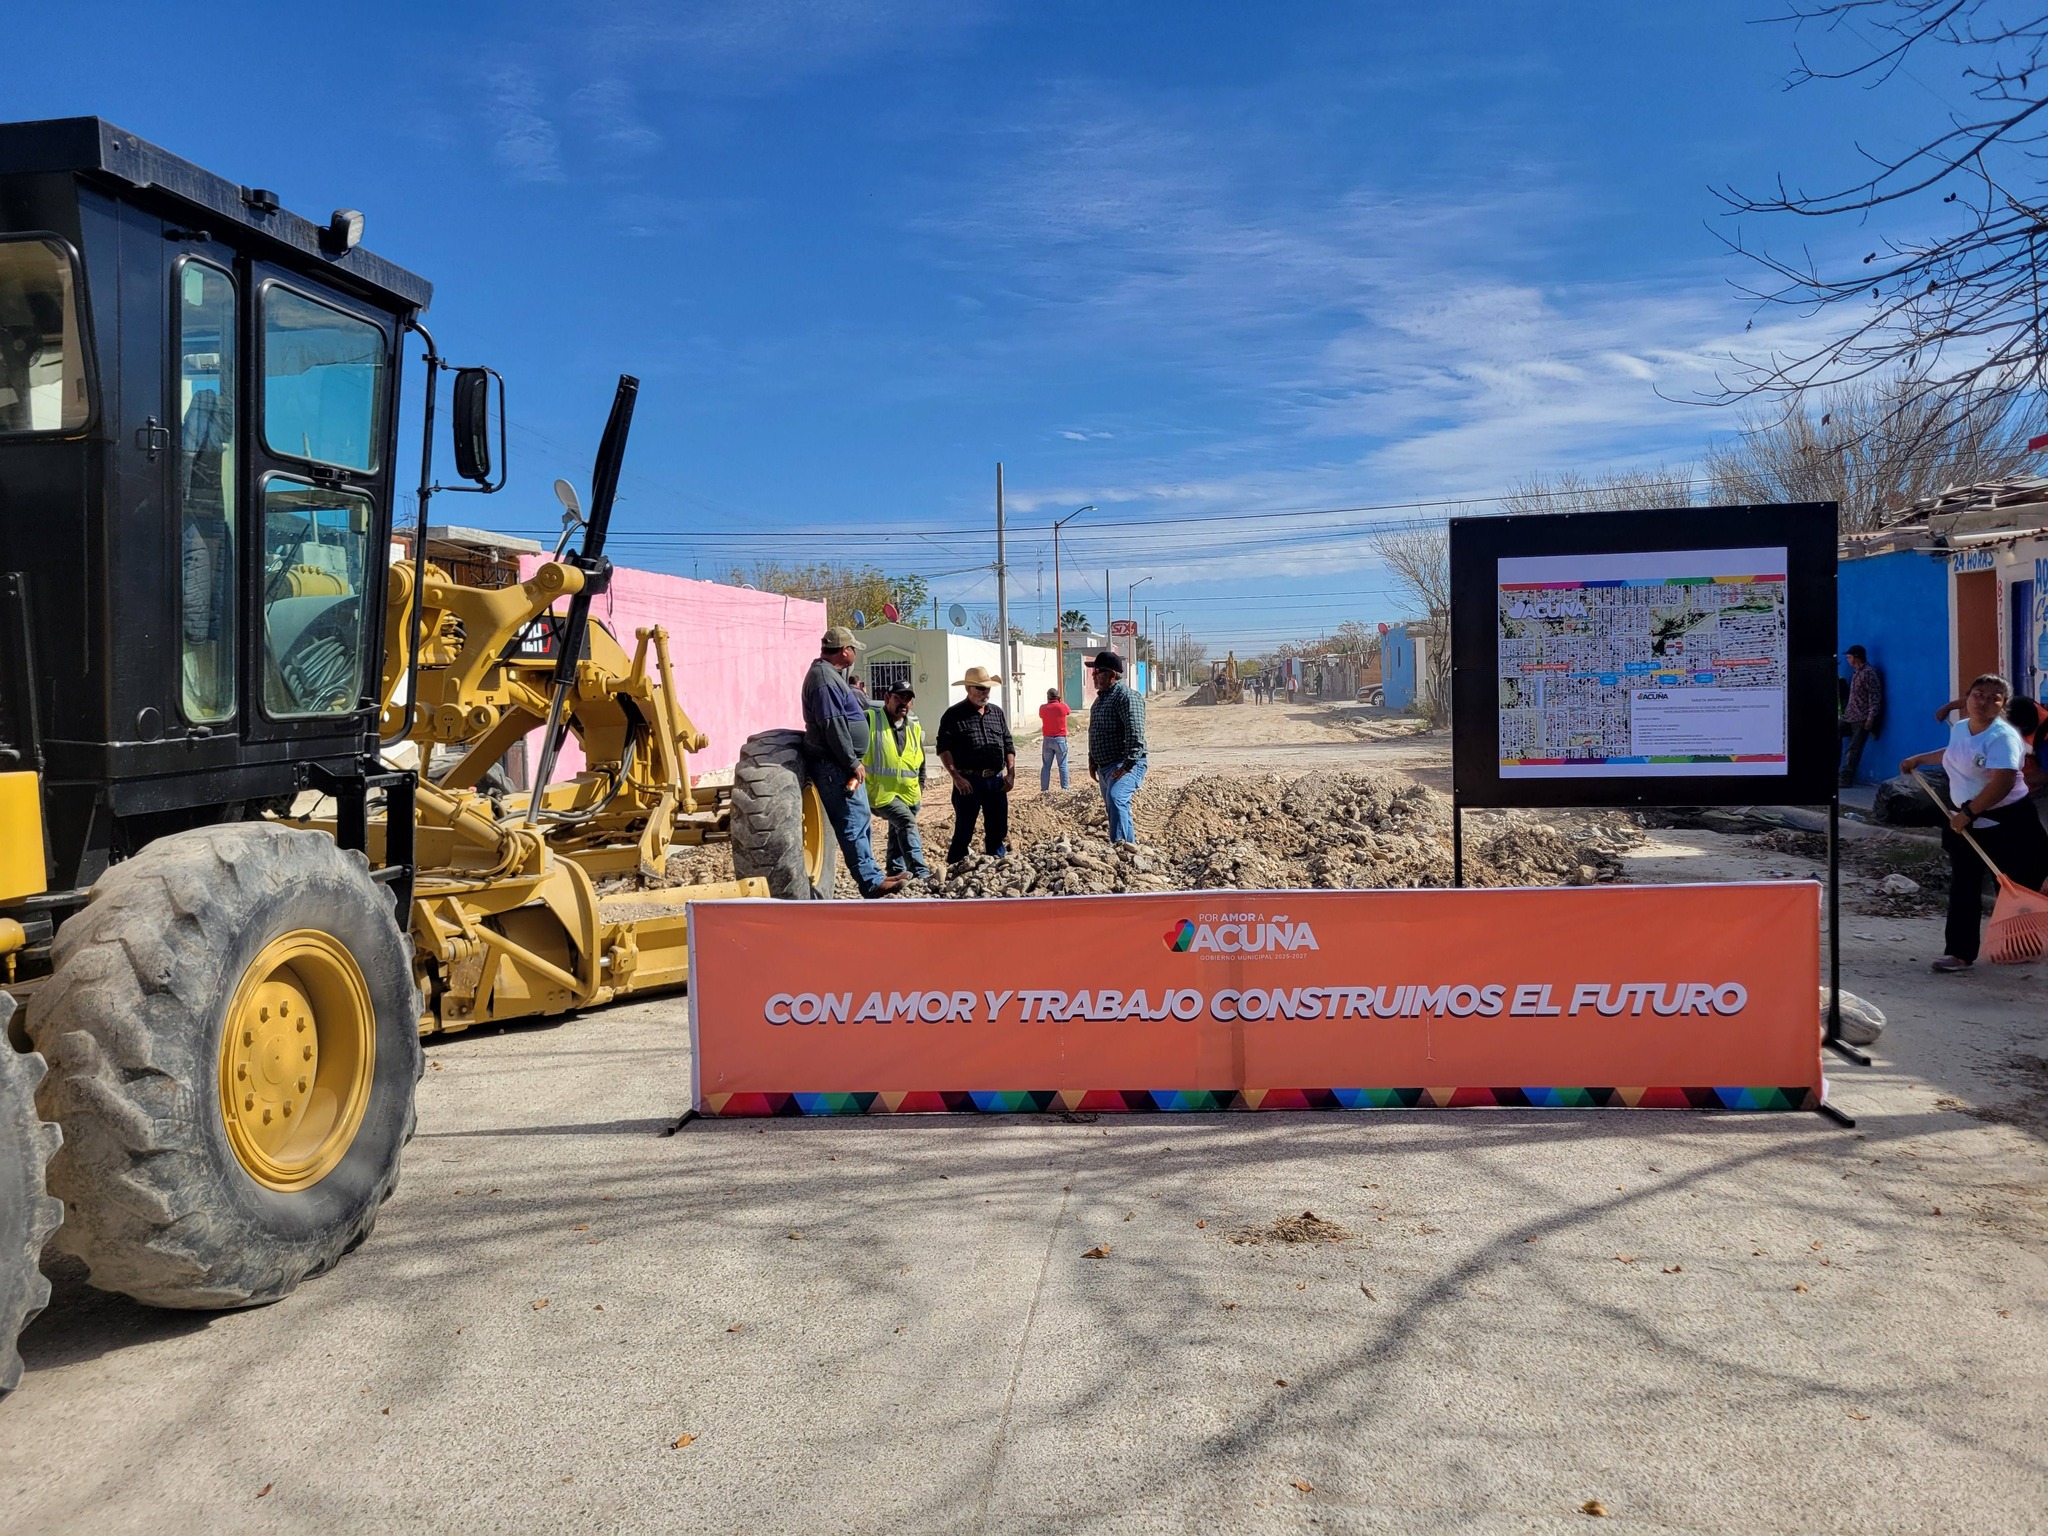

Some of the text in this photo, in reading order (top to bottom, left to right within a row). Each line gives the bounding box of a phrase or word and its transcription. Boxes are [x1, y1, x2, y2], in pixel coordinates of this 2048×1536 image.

[1953, 553, 1965, 572] 24
[1198, 913, 1265, 922] POR AMOR A
[1189, 915, 1320, 953] ACUÑA
[763, 981, 1748, 1026] CON AMOR Y TRABAJO CONSTRUIMOS EL FUTURO
